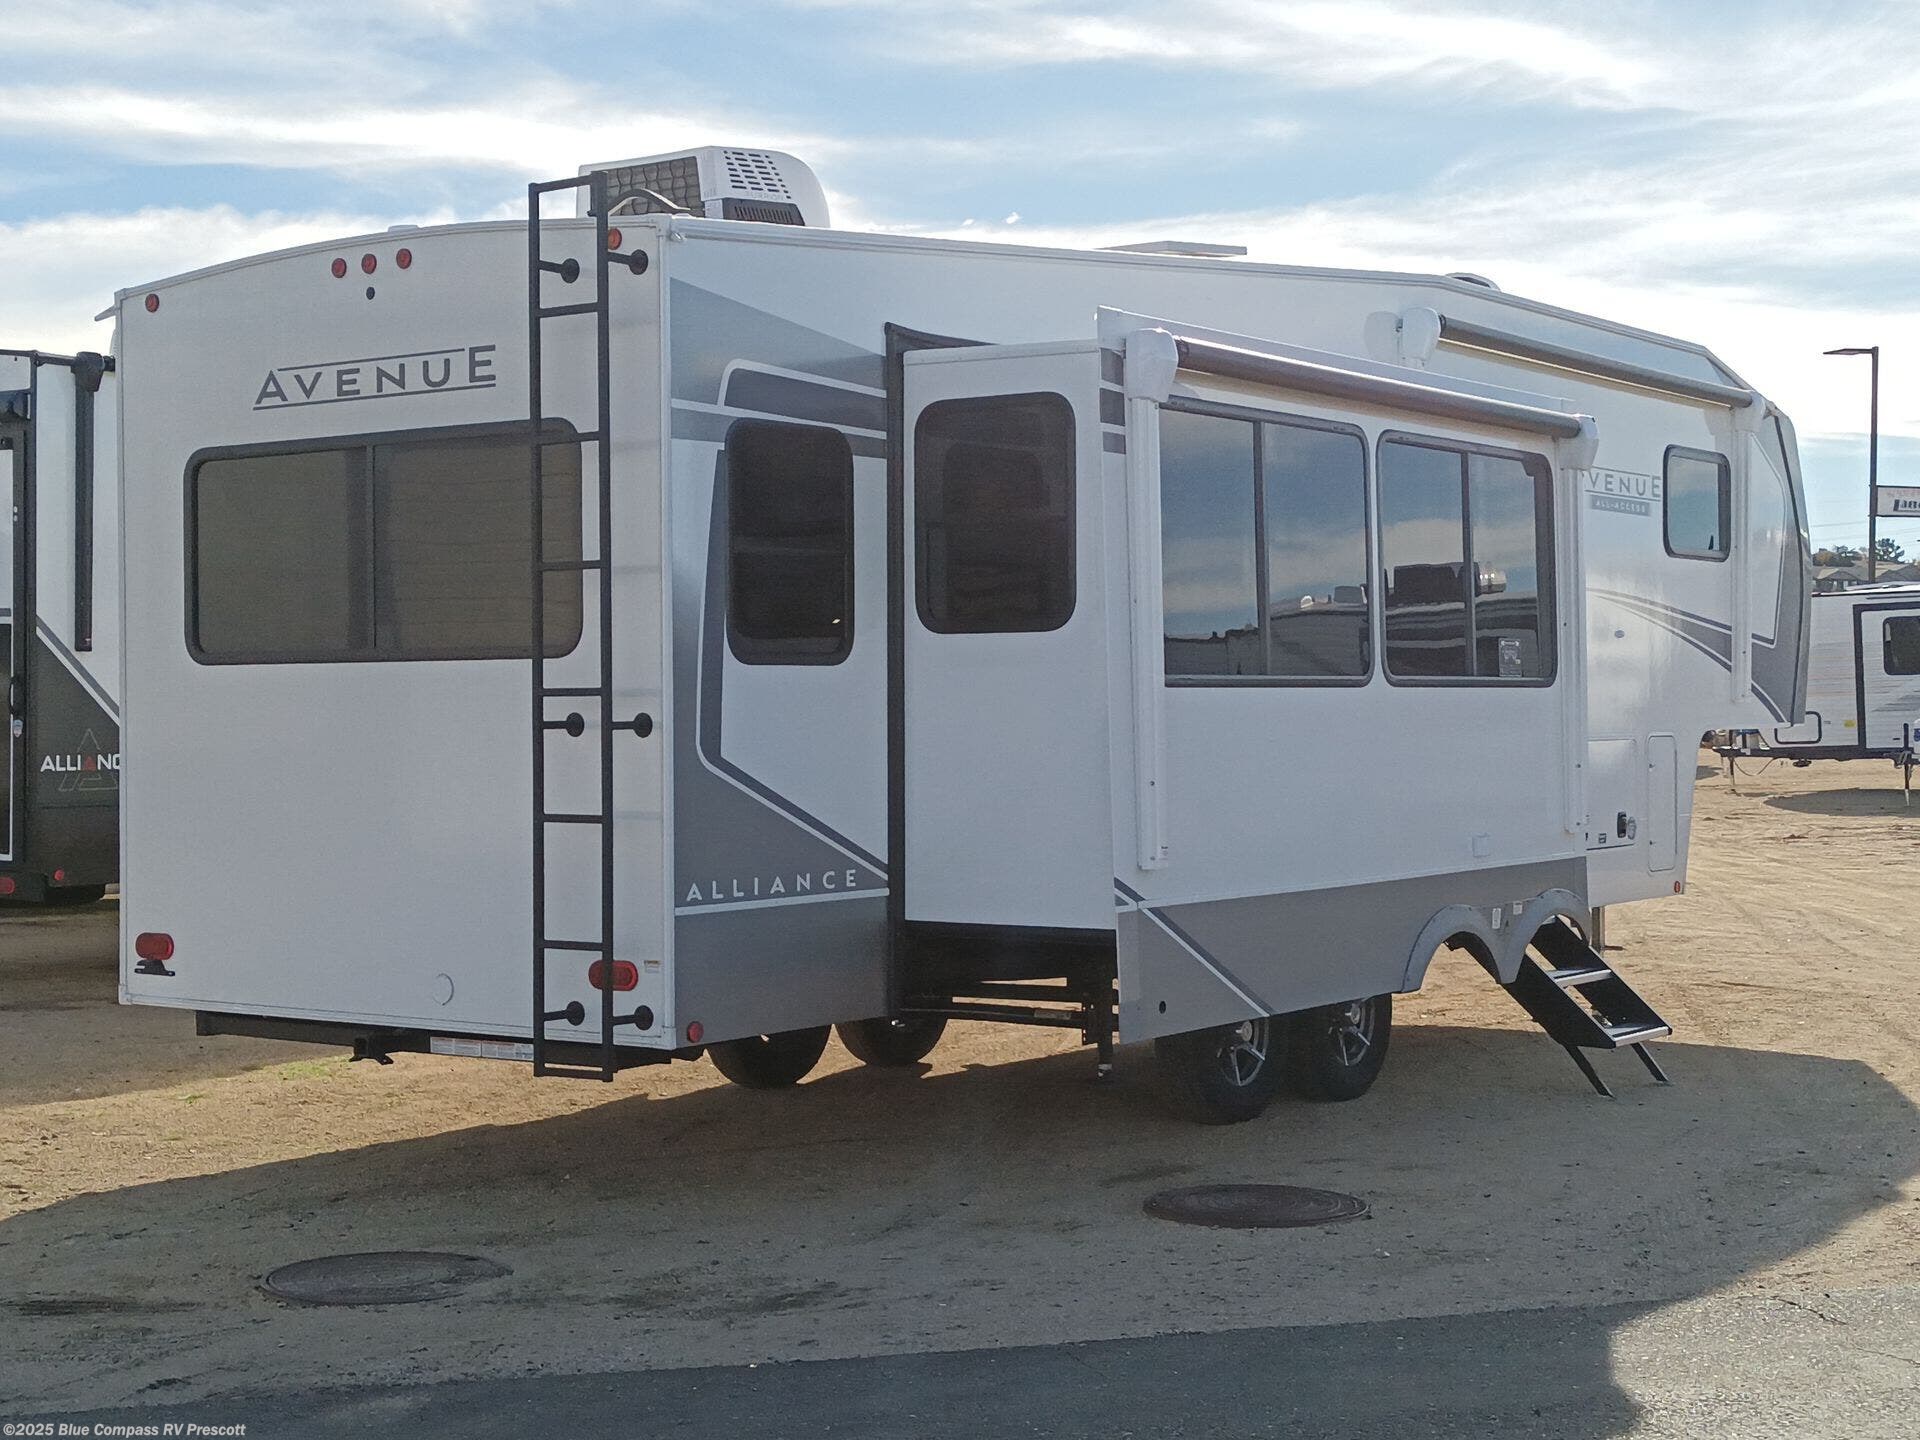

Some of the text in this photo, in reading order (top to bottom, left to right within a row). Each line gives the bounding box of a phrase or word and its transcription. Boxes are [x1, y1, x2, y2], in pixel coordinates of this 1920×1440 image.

[254, 344, 497, 406] AVENUE
[1588, 471, 1662, 498] VENUE
[40, 753, 120, 772] ALLIANC
[686, 869, 857, 901] ALLIANCE
